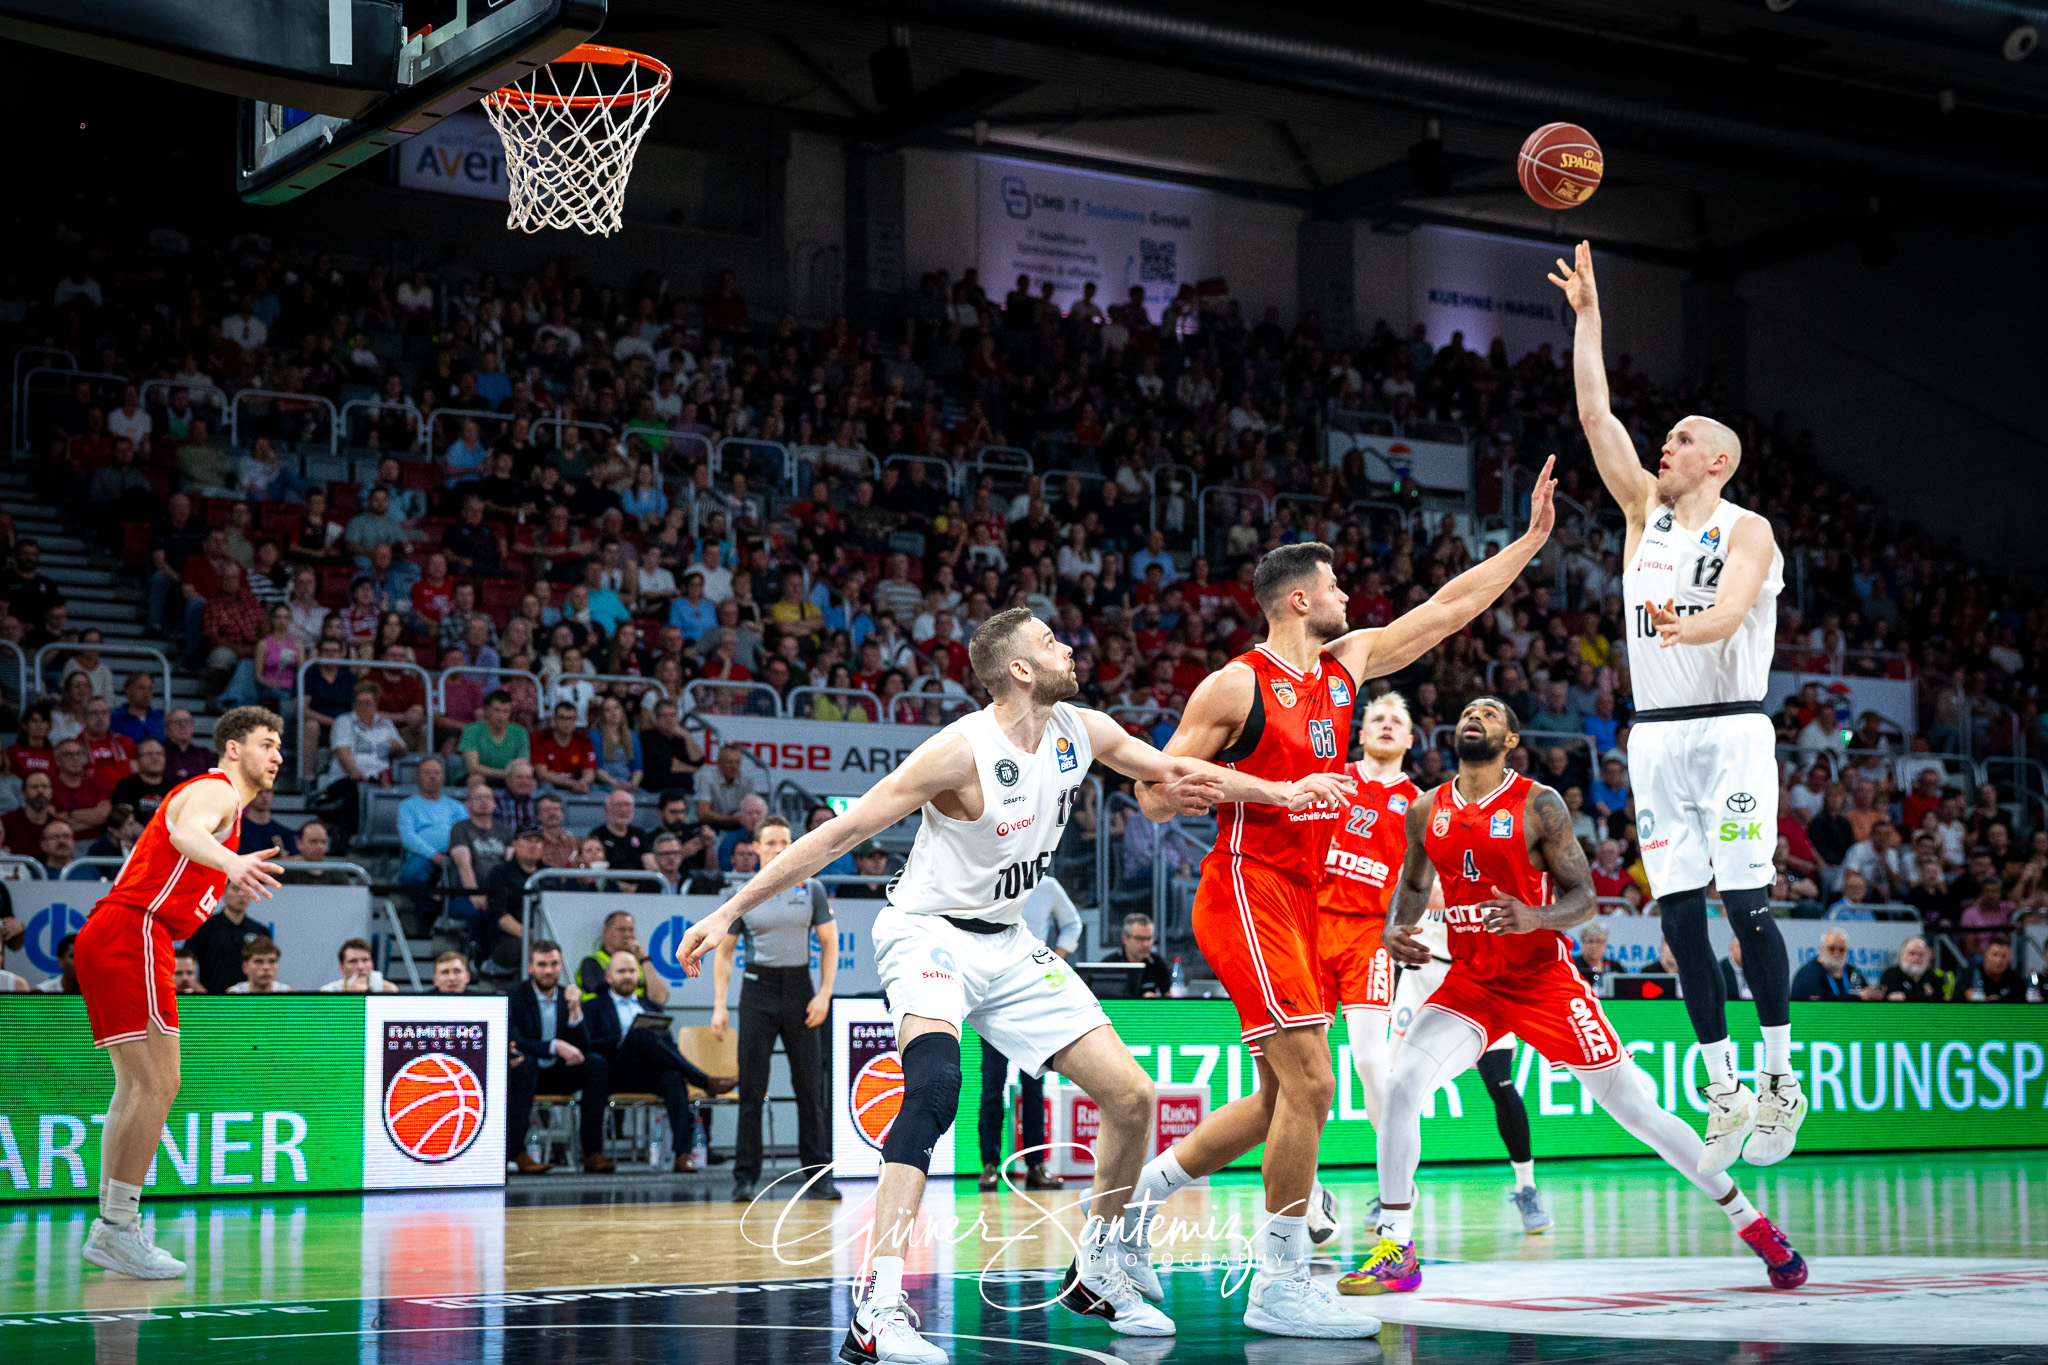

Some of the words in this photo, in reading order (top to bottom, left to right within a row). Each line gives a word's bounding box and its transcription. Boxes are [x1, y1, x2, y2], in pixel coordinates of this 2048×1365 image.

[1692, 555, 1724, 588] 12
[1309, 719, 1337, 759] 65
[1003, 796, 1022, 805] CRAFT
[1345, 804, 1379, 839] 22
[1719, 822, 1763, 842] S+K
[1463, 849, 1481, 881] 4
[0, 1111, 309, 1189] ARNER
[869, 1270, 878, 1293] CRAFT
